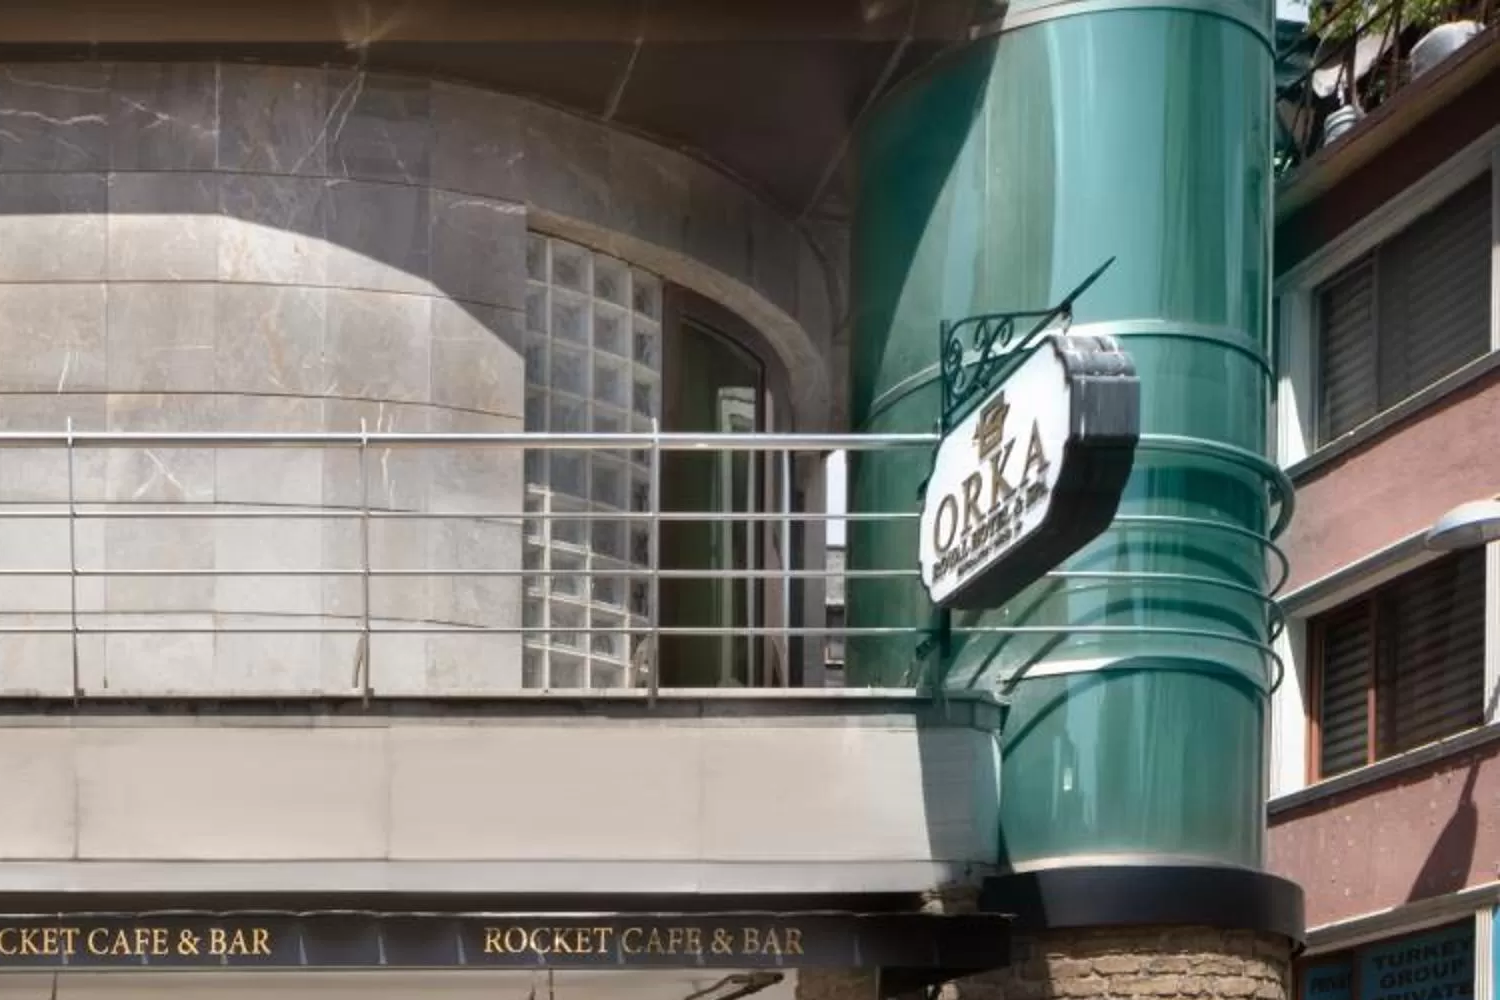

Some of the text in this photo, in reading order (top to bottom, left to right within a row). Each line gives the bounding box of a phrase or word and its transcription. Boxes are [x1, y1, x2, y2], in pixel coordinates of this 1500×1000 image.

[933, 418, 1050, 554] ORKA
[87, 926, 172, 956] CAFE
[177, 928, 201, 956] &
[208, 926, 273, 956] BAR
[482, 926, 805, 956] ROCKET CAFE & BAR
[1379, 956, 1466, 989] GROUP
